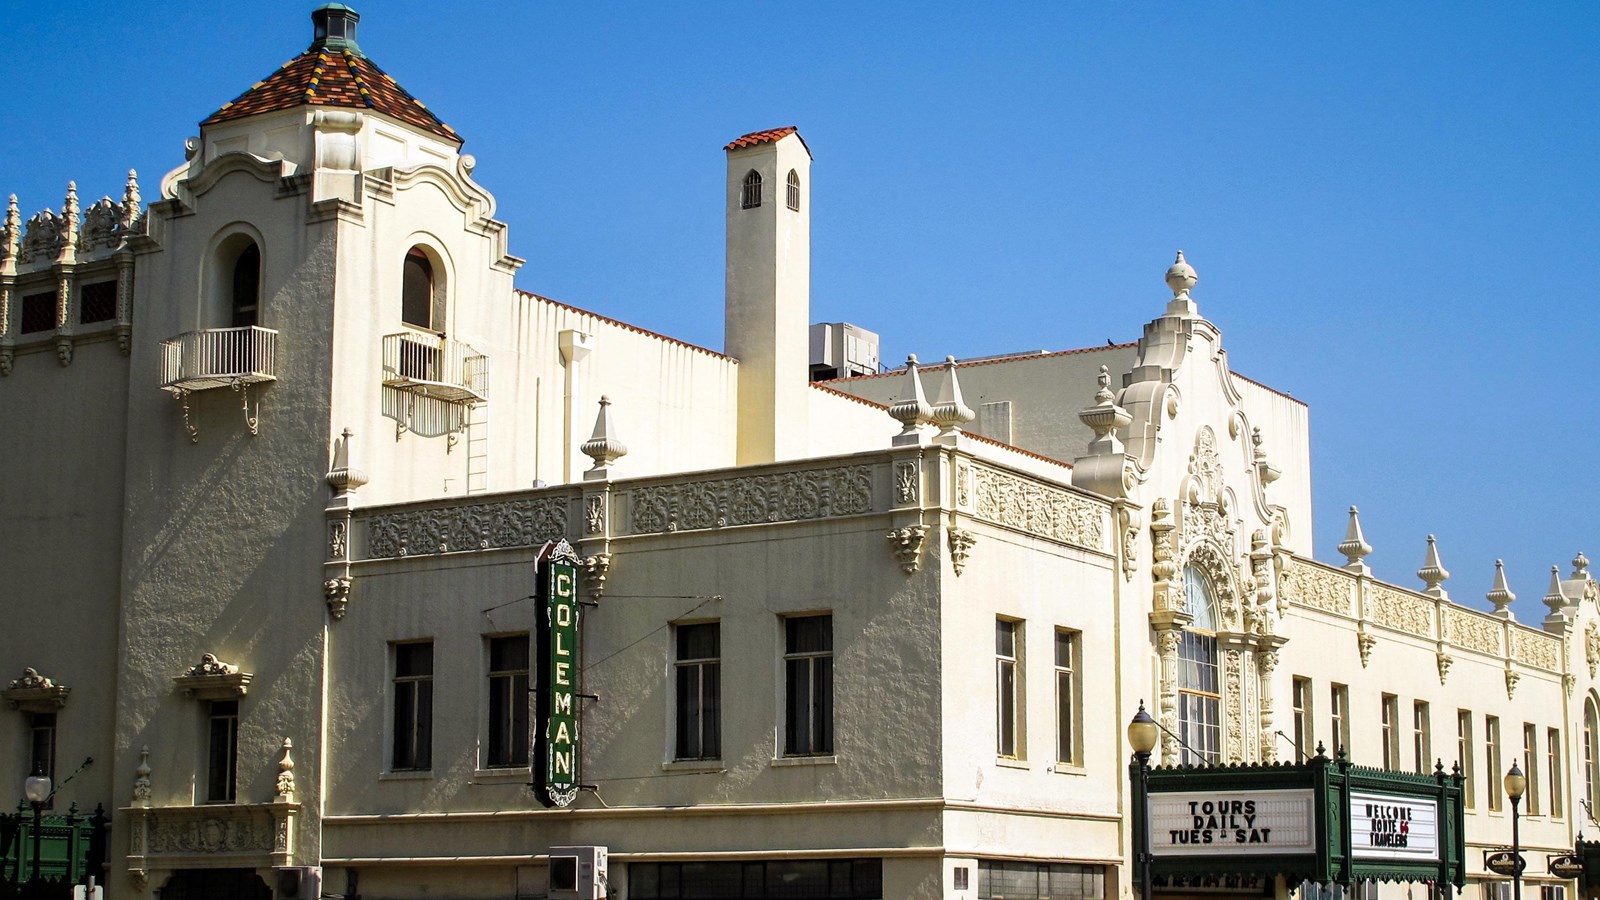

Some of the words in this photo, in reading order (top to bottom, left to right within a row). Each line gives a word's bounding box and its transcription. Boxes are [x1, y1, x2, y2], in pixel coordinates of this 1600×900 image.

[555, 573, 571, 775] COLEMAN
[1188, 800, 1256, 815] TOURS
[1365, 803, 1412, 821] WELCOME
[1193, 814, 1256, 829] DAILY
[1371, 818, 1397, 833] ROUTE
[1399, 820, 1409, 834] 66
[1169, 829, 1213, 844] TUES
[1235, 828, 1271, 843] SAT
[1370, 832, 1408, 848] TRAVELERS
